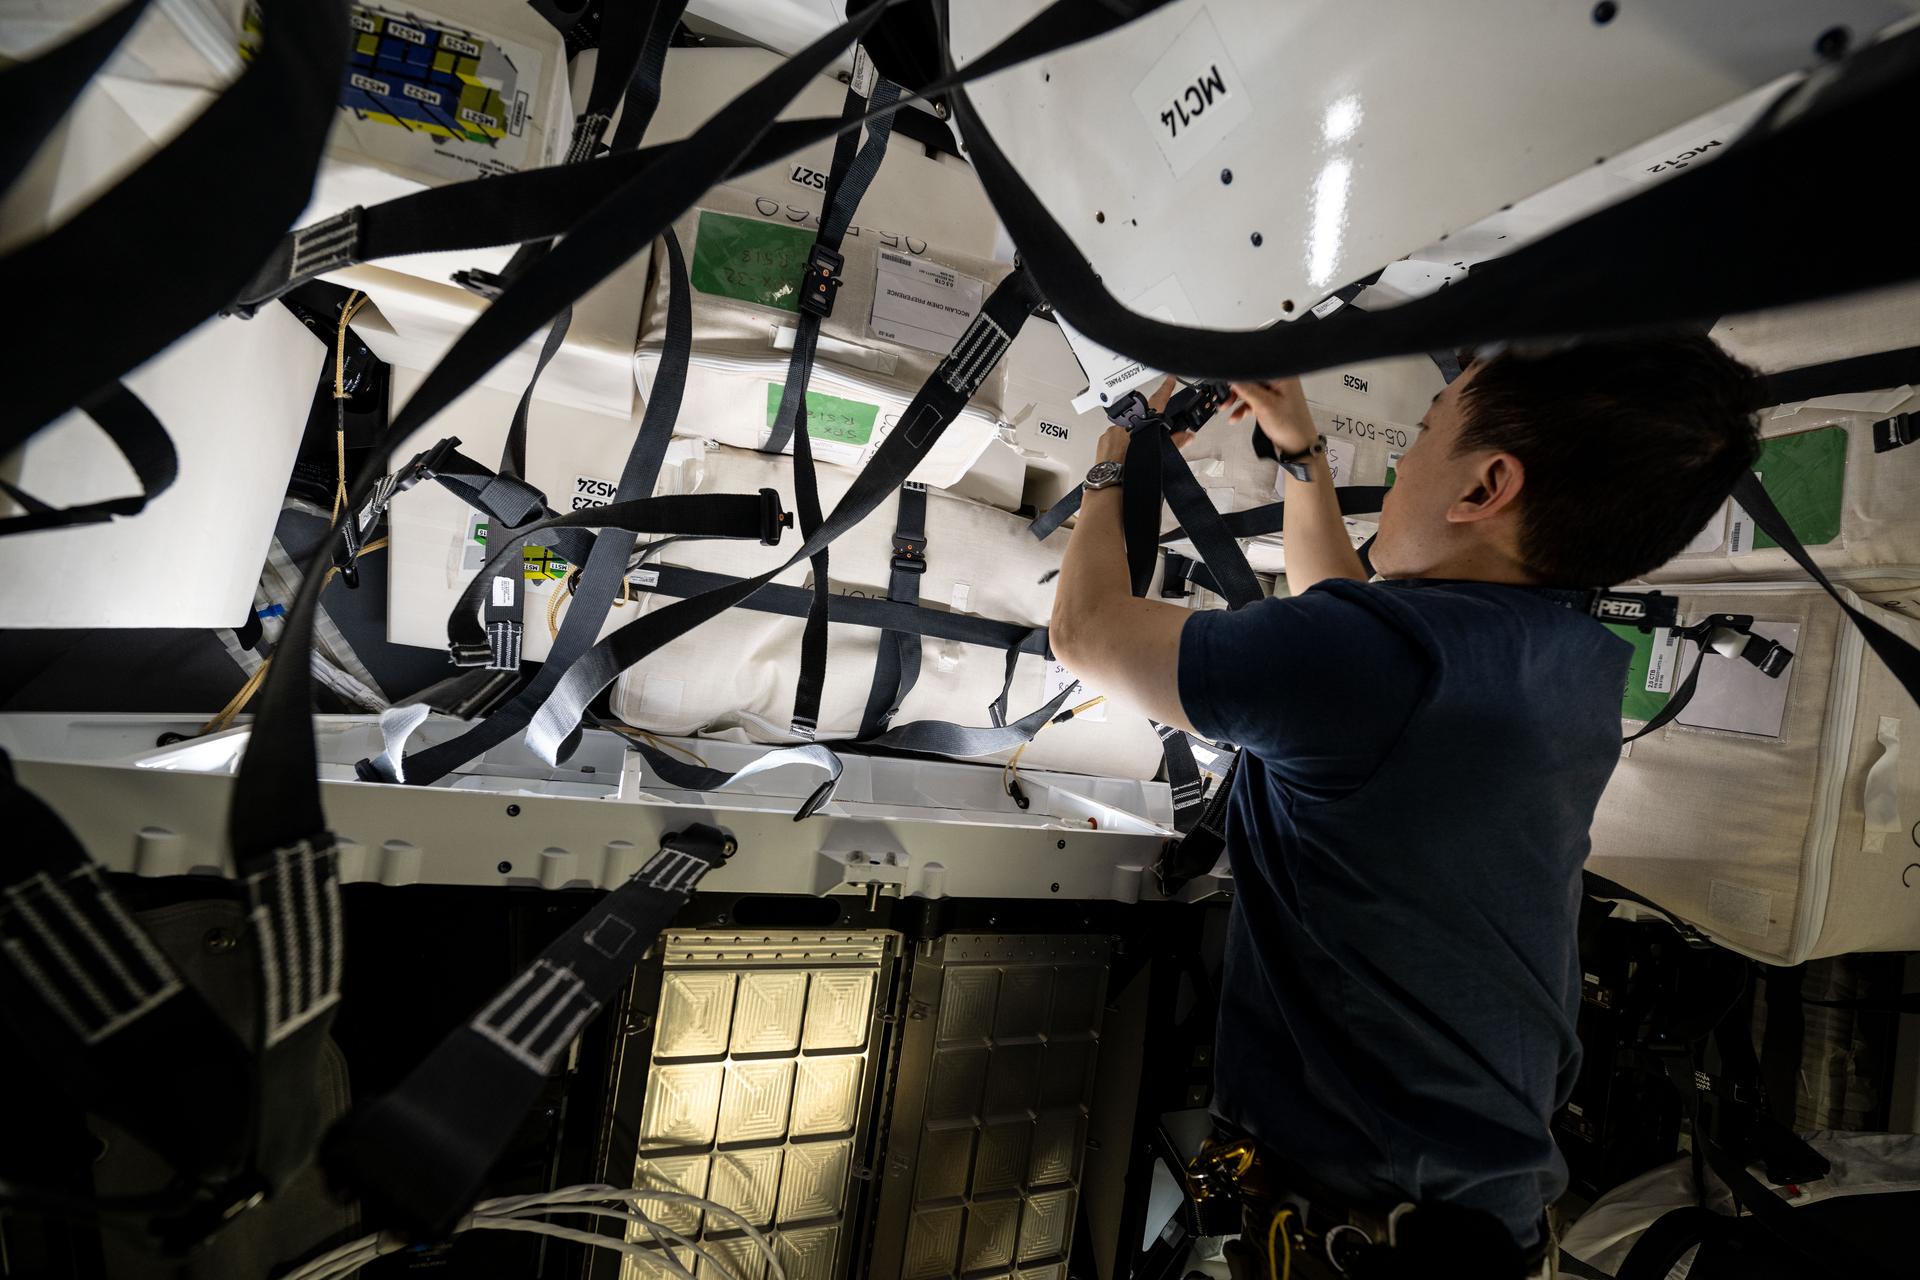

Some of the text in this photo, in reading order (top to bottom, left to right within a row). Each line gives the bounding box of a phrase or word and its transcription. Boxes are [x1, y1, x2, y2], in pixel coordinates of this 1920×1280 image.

[391, 25, 423, 41] MS26
[446, 37, 476, 53] MS25
[354, 76, 387, 93] MS23
[406, 86, 437, 102] MS22
[1161, 64, 1226, 138] MC14
[465, 110, 494, 126] MS21
[1646, 140, 1723, 172] MC12
[887, 289, 970, 318] MCCLAIN CREW PREFERENCE
[1105, 376, 1122, 388] PANEL
[1121, 366, 1141, 381] ACCESS
[1343, 374, 1368, 392] MS25
[1040, 422, 1069, 440] MS26
[577, 478, 617, 497] MS24
[572, 497, 609, 510] 23
[1598, 600, 1647, 618] PETZL
